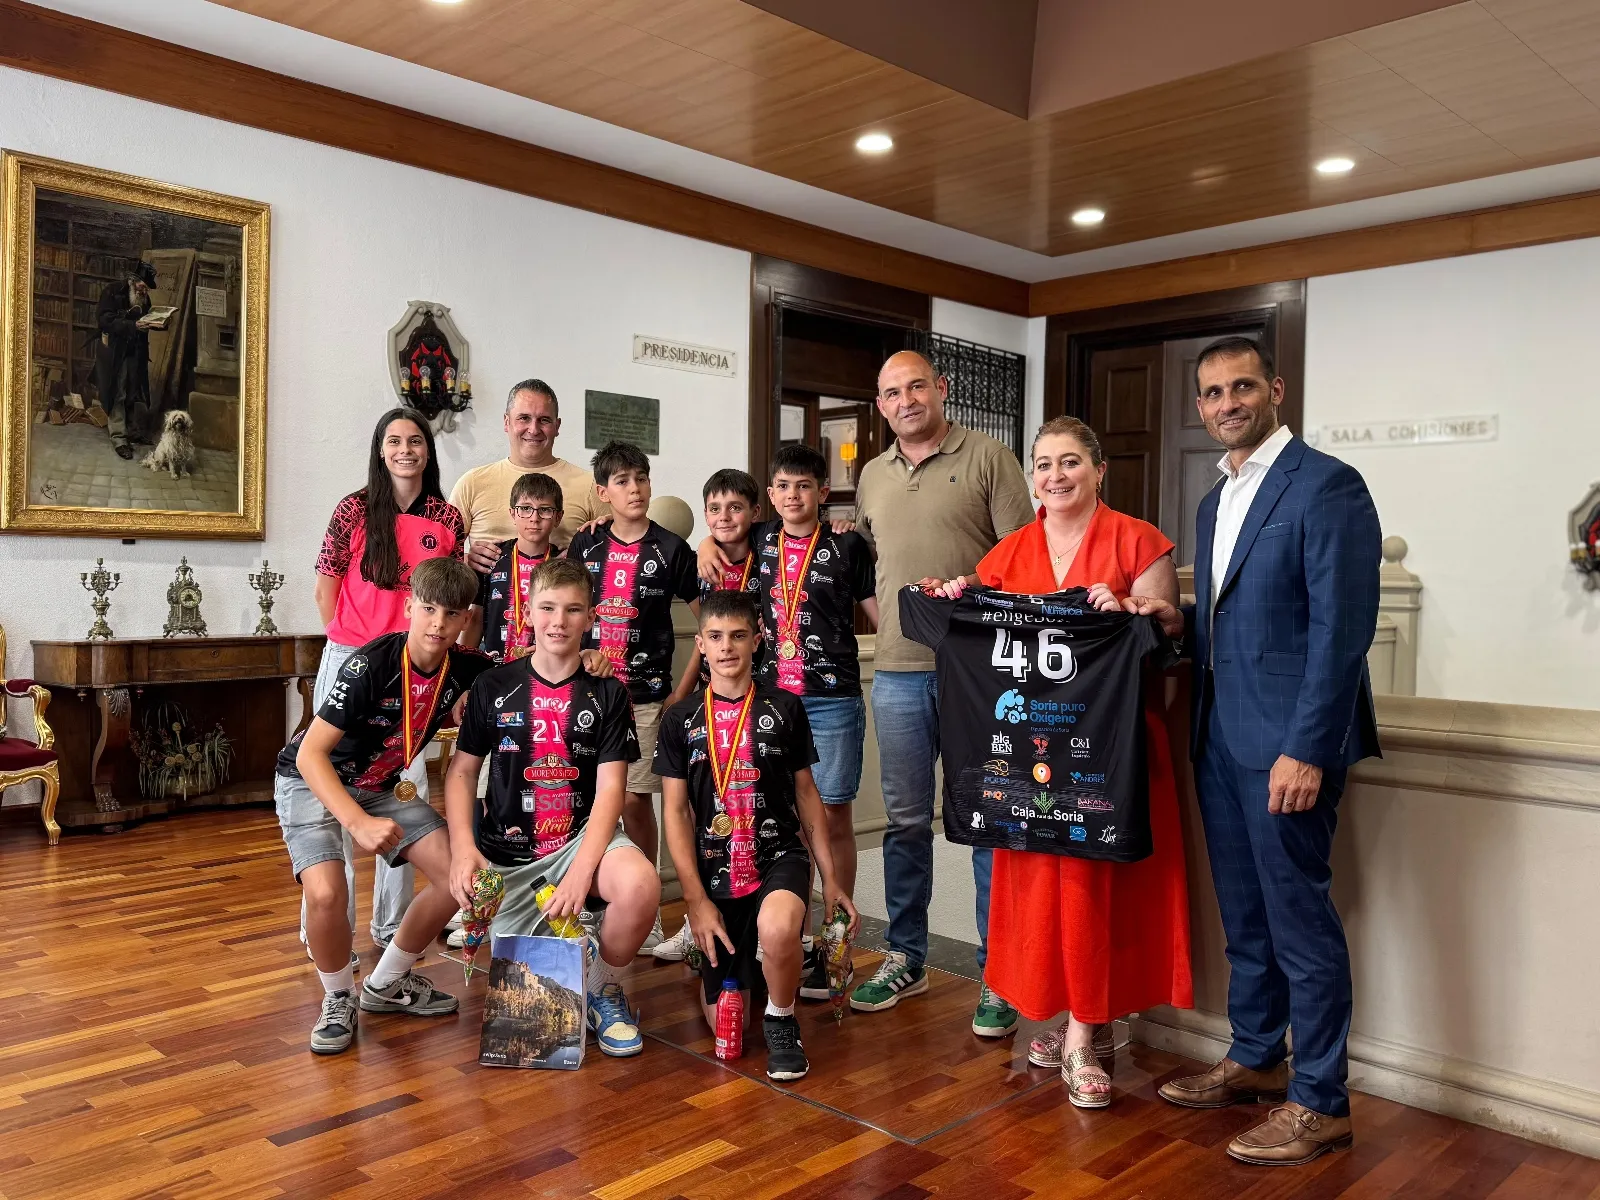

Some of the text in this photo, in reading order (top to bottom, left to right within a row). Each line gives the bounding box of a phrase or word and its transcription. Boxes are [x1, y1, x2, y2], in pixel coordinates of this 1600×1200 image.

[642, 341, 730, 369] PRESIDENCIA
[1331, 420, 1488, 443] SALA COMISIONES
[786, 554, 799, 572] 2
[613, 569, 627, 588] 8
[521, 579, 531, 596] 5
[601, 627, 640, 643] Soria
[991, 627, 1078, 684] 46
[414, 702, 427, 720] 7
[1029, 699, 1086, 714] Soria puro
[1029, 711, 1077, 726] Oxígeno
[532, 719, 563, 744] 21
[991, 731, 1010, 744] BIG
[991, 743, 1013, 753] BEN
[1070, 737, 1091, 749] C&I
[531, 768, 558, 778] MORENO
[539, 793, 584, 812] Soria
[728, 794, 766, 809] Soria
[1011, 805, 1036, 820] Caja
[1053, 809, 1084, 823] Soria
